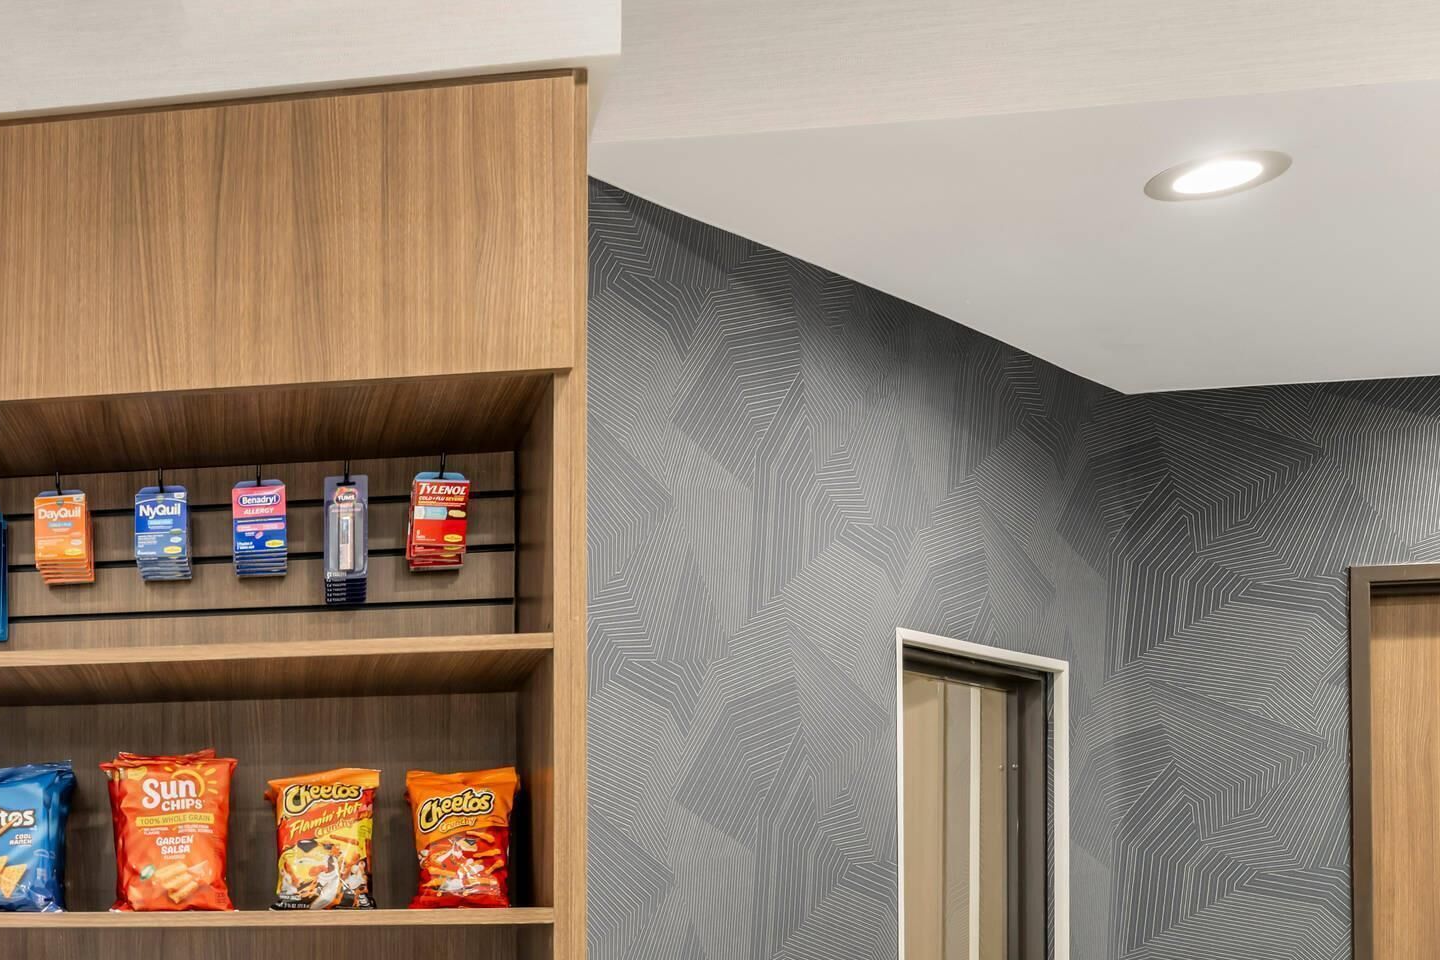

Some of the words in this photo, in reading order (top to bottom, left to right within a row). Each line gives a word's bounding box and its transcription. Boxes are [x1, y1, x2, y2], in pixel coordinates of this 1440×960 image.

[418, 483, 467, 495] TYLENOL
[242, 495, 277, 505] Benadryl
[38, 507, 81, 521] DayQuil
[139, 504, 181, 518] NyQuil
[243, 507, 274, 515] ALLERGY
[142, 778, 197, 809] Sun
[285, 784, 361, 814] Cheetos
[161, 799, 203, 811] CHIPS
[420, 789, 493, 831] Cheetos
[162, 815, 188, 824] WHOLE
[188, 813, 211, 823] GRAIN
[156, 834, 194, 846] GARDEN
[160, 844, 191, 855] SALSA
